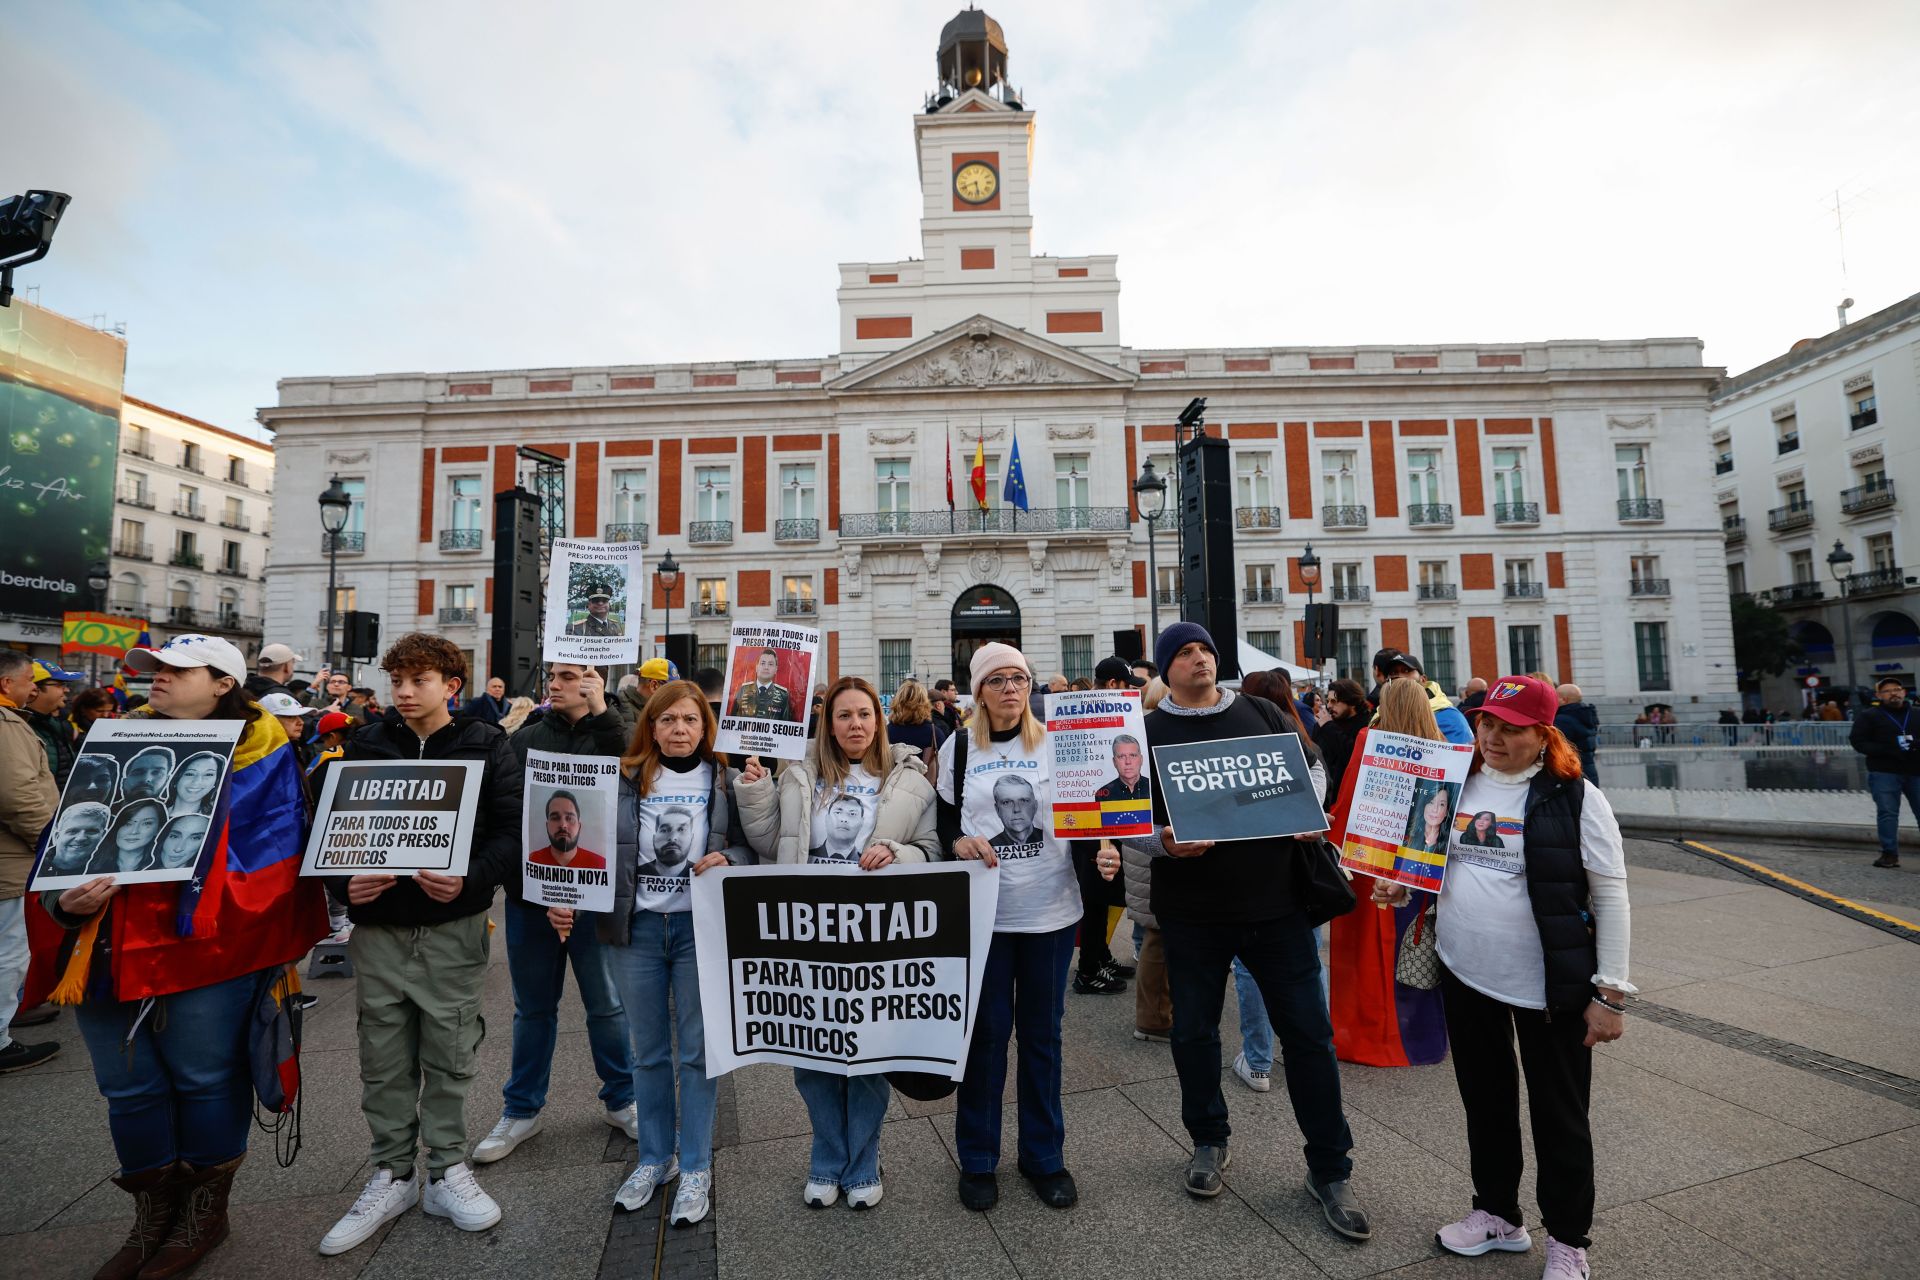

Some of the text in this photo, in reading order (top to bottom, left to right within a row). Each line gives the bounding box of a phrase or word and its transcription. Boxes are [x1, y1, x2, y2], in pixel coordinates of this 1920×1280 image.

[554, 541, 586, 550] LIBERTAD
[567, 552, 593, 560] PRESOS
[0, 570, 76, 593] berdrola
[64, 620, 135, 650] VOX
[732, 627, 819, 644] LIBERTAD PARA TODOS LOS
[742, 637, 801, 650] PRESOS POLÍTICOS
[558, 652, 588, 660] Recluido
[1055, 702, 1133, 717] ALEJANDRO
[772, 723, 804, 737] SEQUEA
[1055, 734, 1095, 742] DETENIDO
[1055, 739, 1112, 748] INJUSTAMENTE
[1383, 734, 1410, 742] LIBERTAD
[1055, 748, 1081, 756] DESDE
[526, 758, 617, 775] LIBERTAD PARA TODOS LOS
[1167, 751, 1286, 776] CENTRO DE
[1372, 756, 1441, 778] SAN MIGUEL
[532, 771, 596, 786] PRESOS POLÍTICOS
[1056, 769, 1104, 778] CIUDADANO
[1171, 766, 1294, 793] TORTURA
[1367, 770, 1410, 784] DETENIDA
[349, 779, 447, 801] LIBERTAD
[1057, 788, 1110, 798] VENEZOLANO
[1251, 786, 1284, 799] RODEO
[1365, 783, 1405, 798] DESDE EL
[1358, 803, 1409, 822] CIUDADANA
[331, 815, 439, 831] PARA TODOS LOS
[327, 833, 450, 848] TODOS LOS PRESOS
[321, 850, 388, 866] POLITICOS
[1473, 846, 1488, 855] San
[1489, 848, 1519, 859] Miguel
[525, 862, 609, 886] FERNANDO NOYA
[639, 876, 691, 886] ERNAND
[646, 884, 684, 893] NOYA
[757, 899, 938, 944] LIBERTAD
[742, 960, 936, 993] PARA TODOS LOS
[742, 990, 961, 1025] TODOS LOS PRESOS
[745, 1020, 858, 1058] POLITICOS
